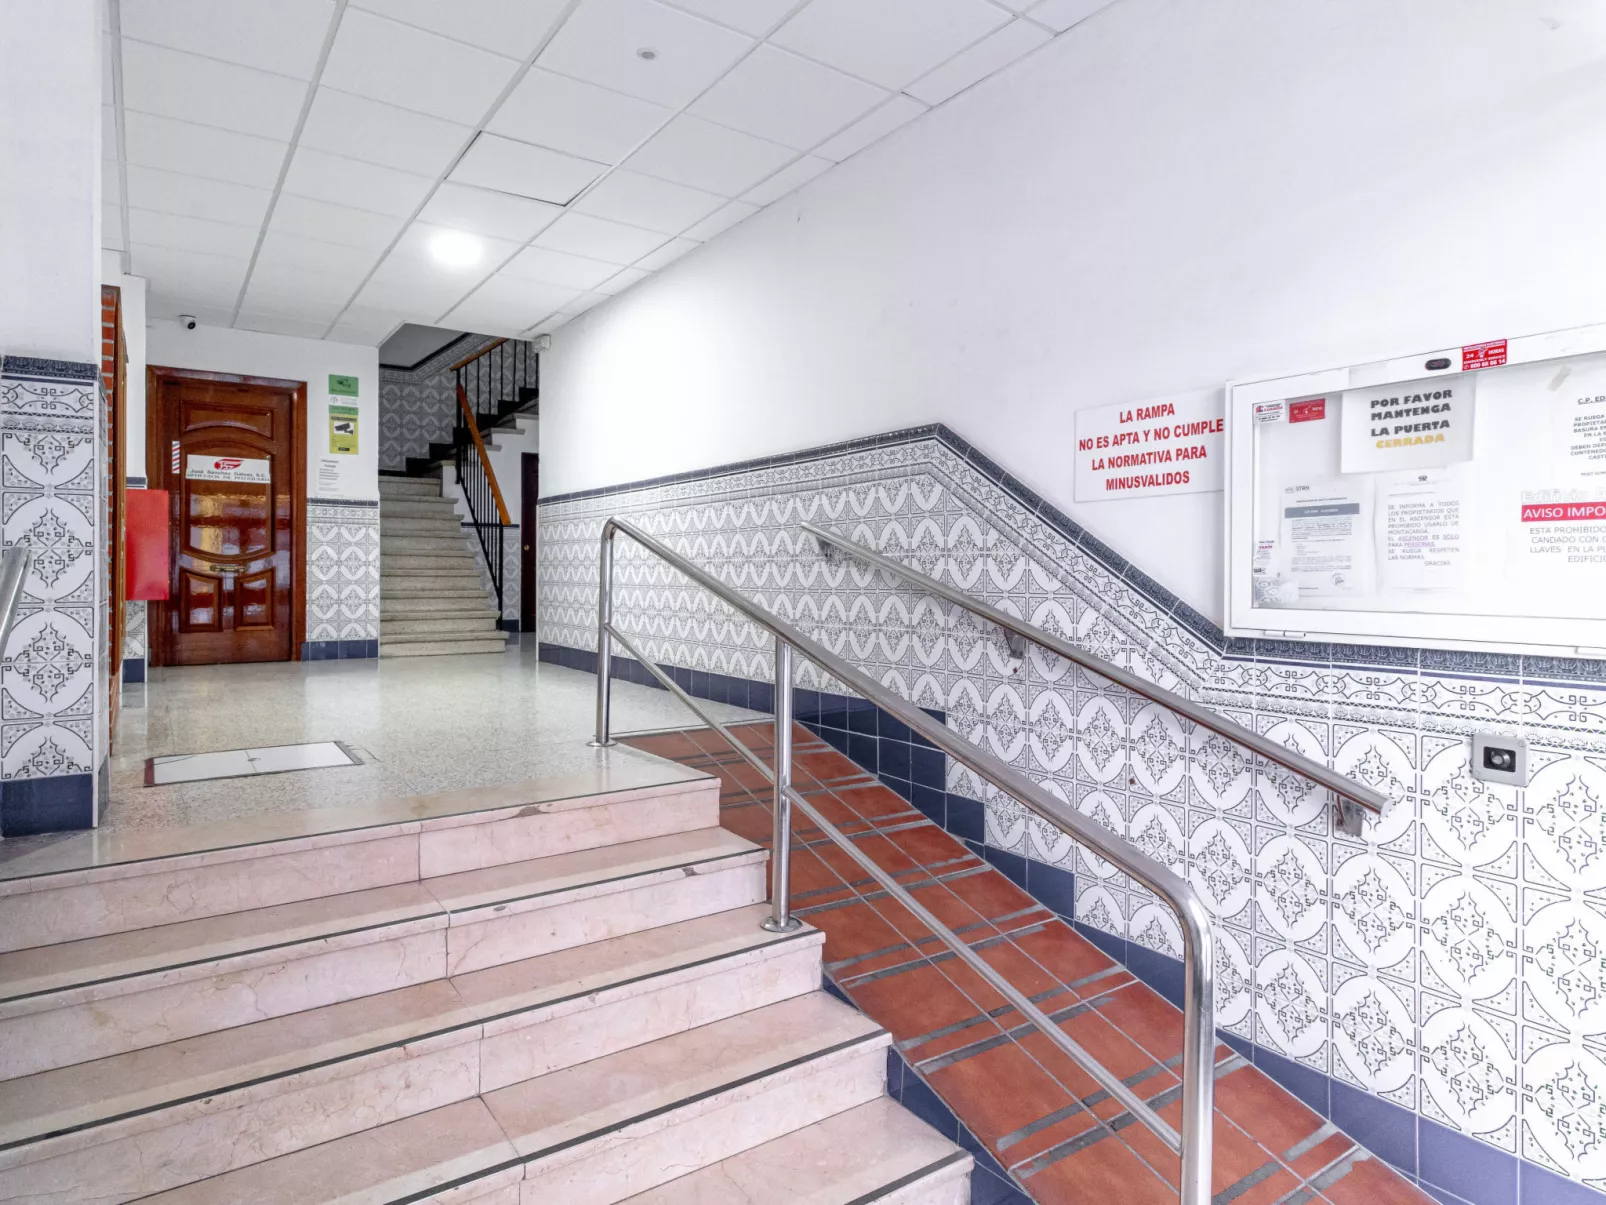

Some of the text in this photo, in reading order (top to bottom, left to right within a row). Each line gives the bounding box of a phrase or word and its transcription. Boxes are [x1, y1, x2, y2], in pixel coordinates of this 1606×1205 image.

[1371, 390, 1452, 408] POR FAVOR
[1120, 403, 1175, 424] LA RAMPA
[1371, 403, 1451, 420] MANTENGA
[1079, 419, 1224, 451] NO ES APTA Y NO CUMPLE
[1371, 420, 1450, 436] LA PUERTA
[1376, 434, 1445, 448] CERRADA
[1092, 445, 1207, 470] LA NORMATIVA PARA
[1106, 471, 1189, 490] MINUSVALIDOS
[1524, 506, 1606, 518] AVISO IMPO
